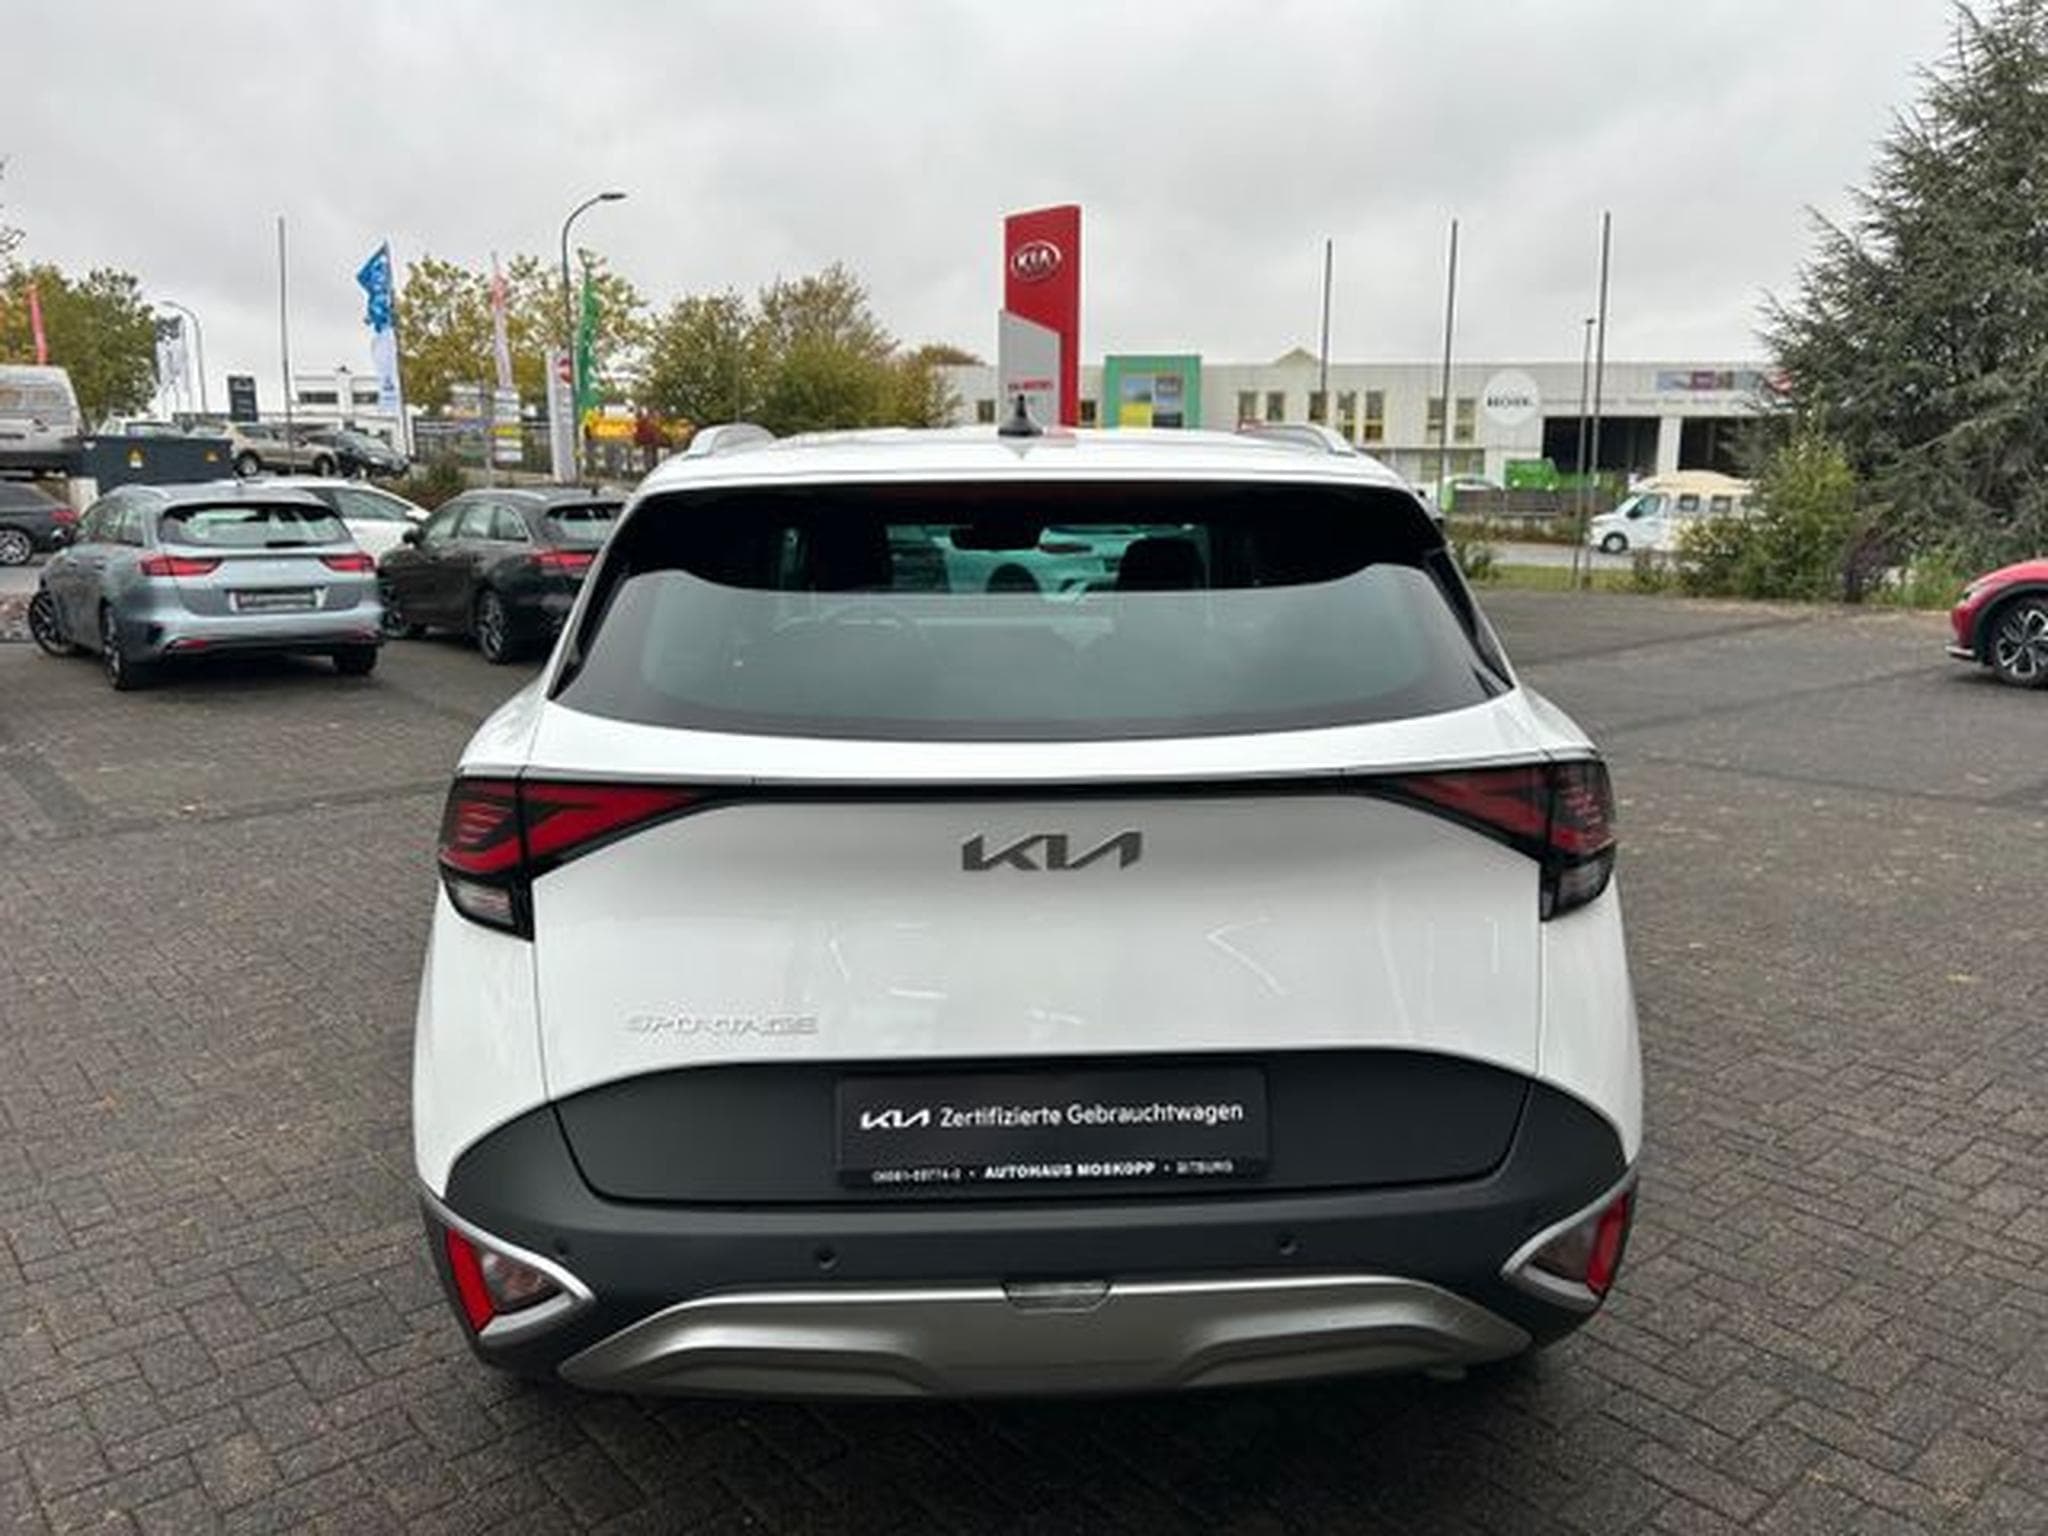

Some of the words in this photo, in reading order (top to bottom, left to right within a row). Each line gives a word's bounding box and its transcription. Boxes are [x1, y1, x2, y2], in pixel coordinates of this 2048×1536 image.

[1017, 249, 1051, 270] KIA
[962, 831, 1143, 871] KIA
[861, 1108, 931, 1129] KIA
[940, 1105, 1062, 1128] Zertifizierte
[1066, 1102, 1244, 1126] Gebrauchtwagen
[985, 1163, 1073, 1180] AUTOHAUS
[1077, 1160, 1156, 1177] MOSKOPP
